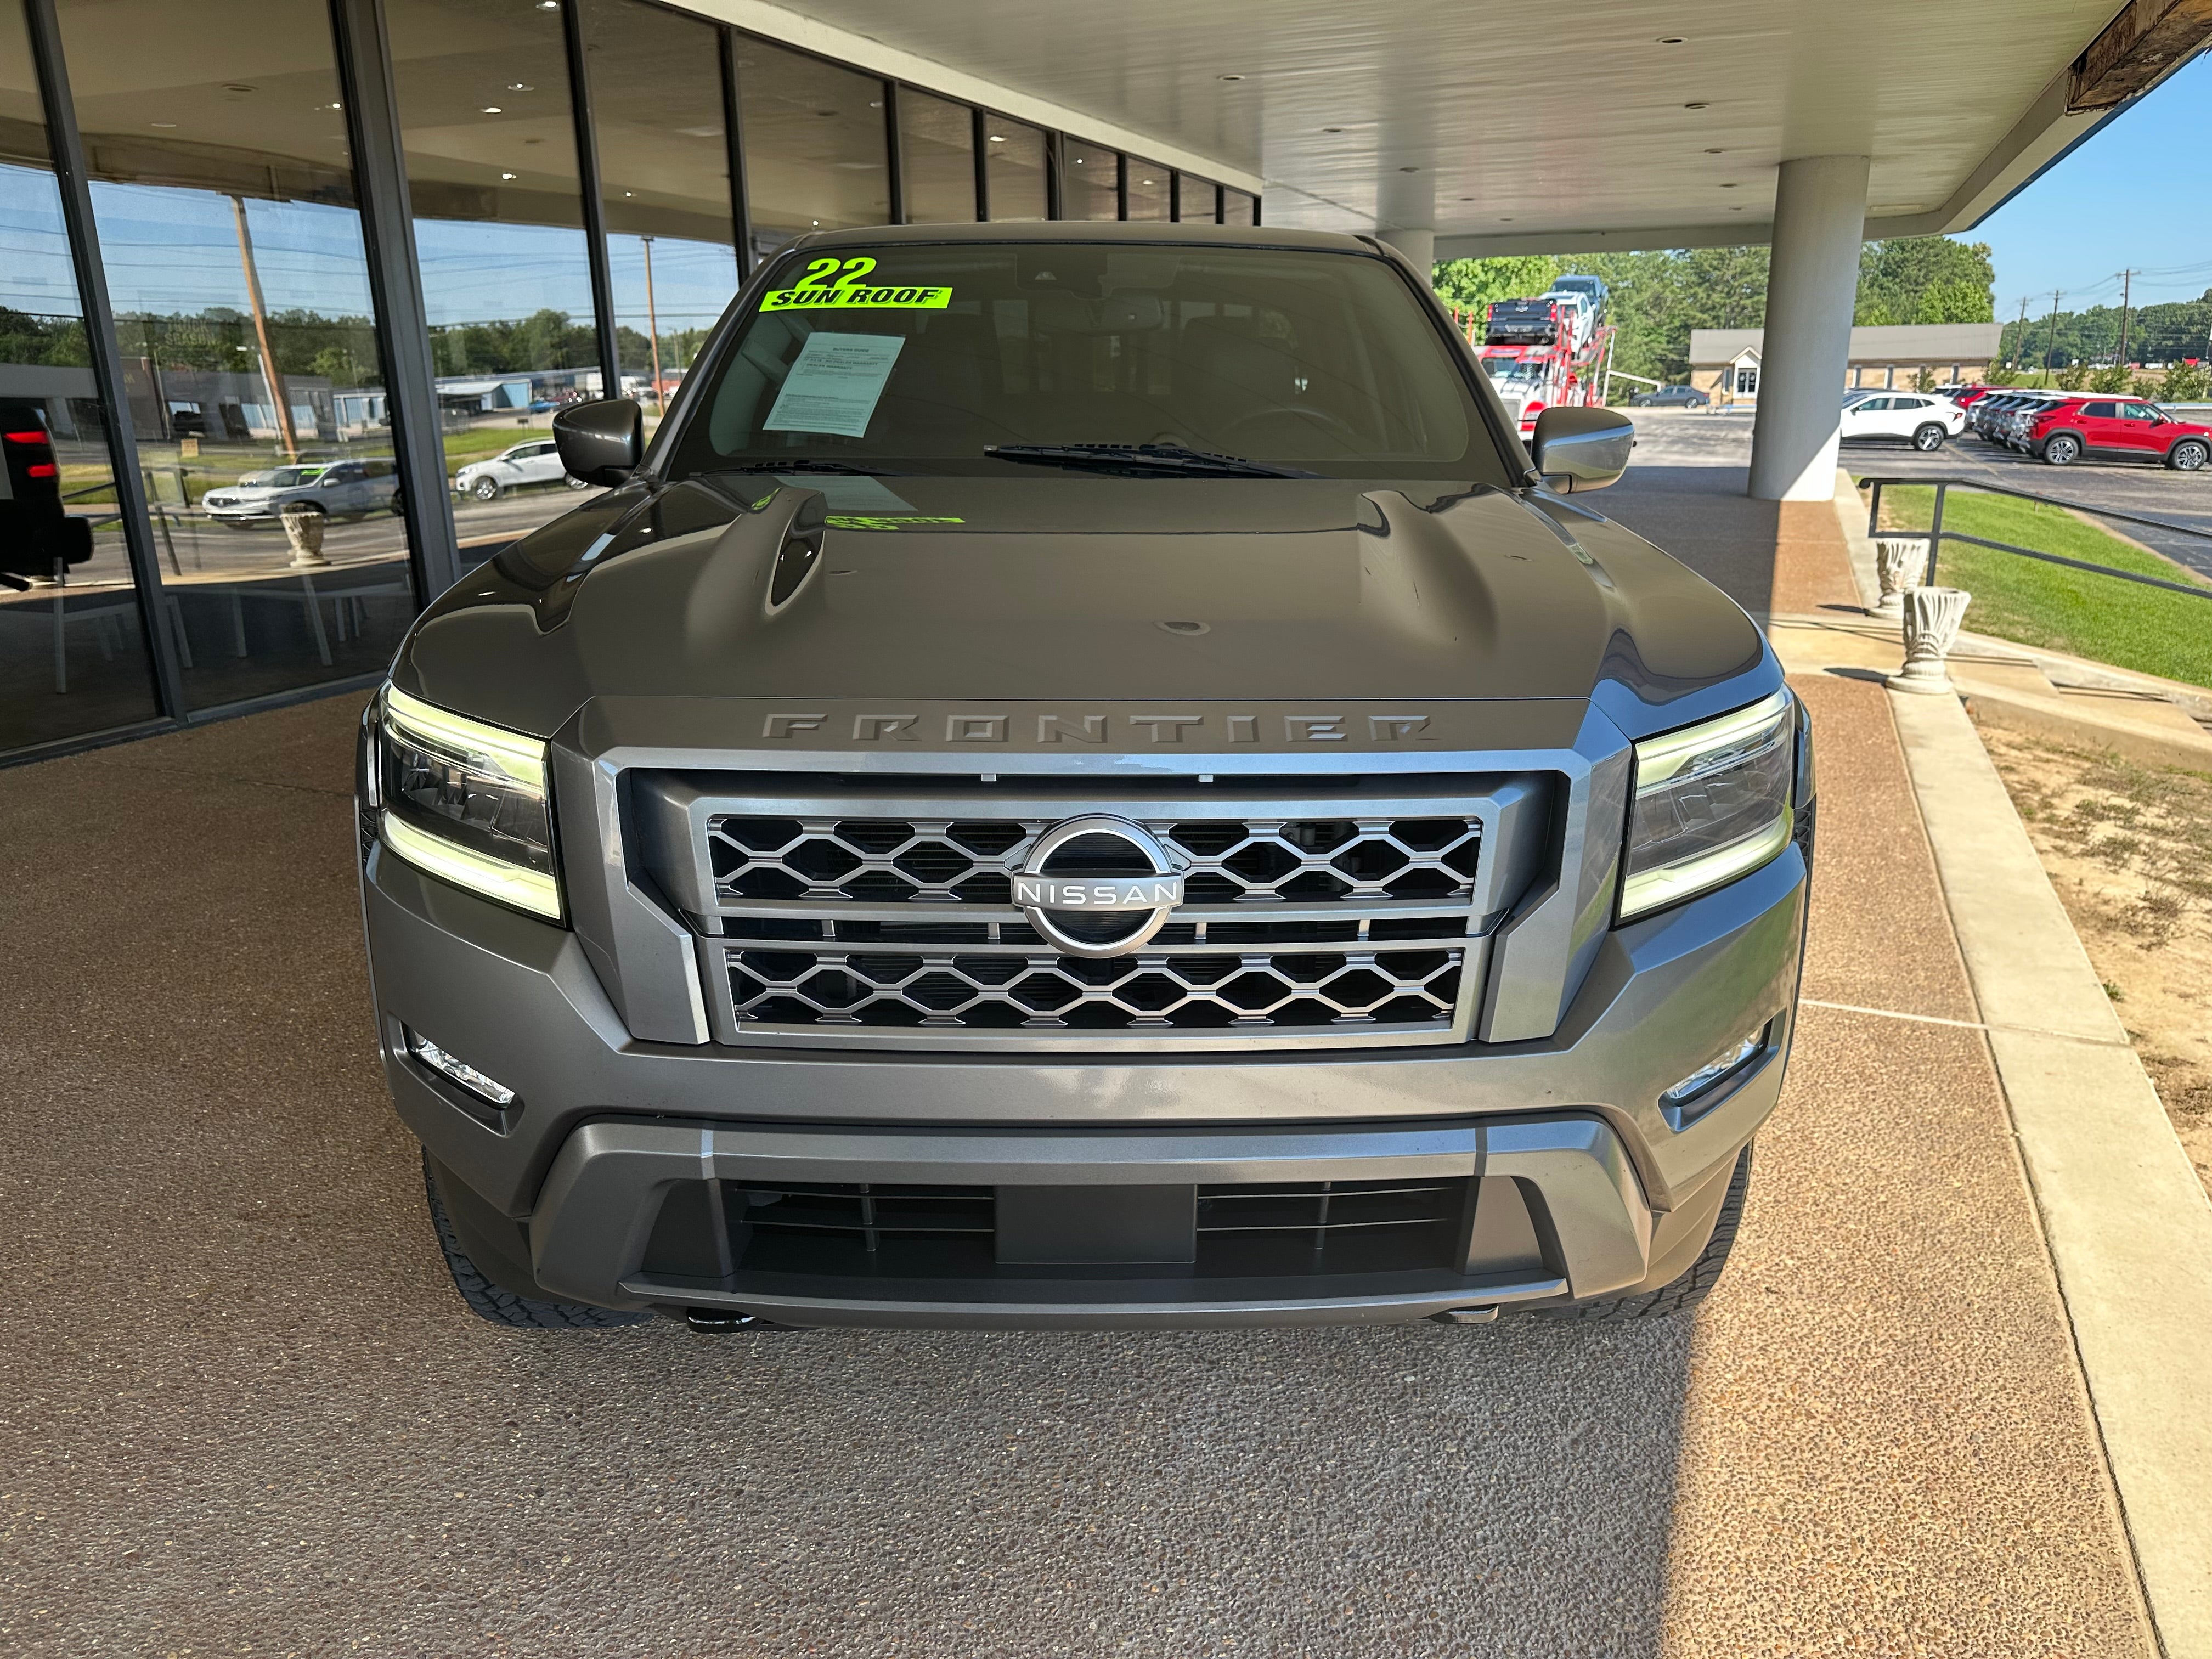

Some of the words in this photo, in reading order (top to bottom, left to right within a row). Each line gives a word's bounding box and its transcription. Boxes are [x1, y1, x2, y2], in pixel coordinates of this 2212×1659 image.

[795, 257, 877, 289] 22
[771, 290, 845, 307] SUN
[848, 289, 942, 304] ROOF
[762, 713, 1440, 743] FRONTIER
[1017, 882, 1177, 905] NISSAN
